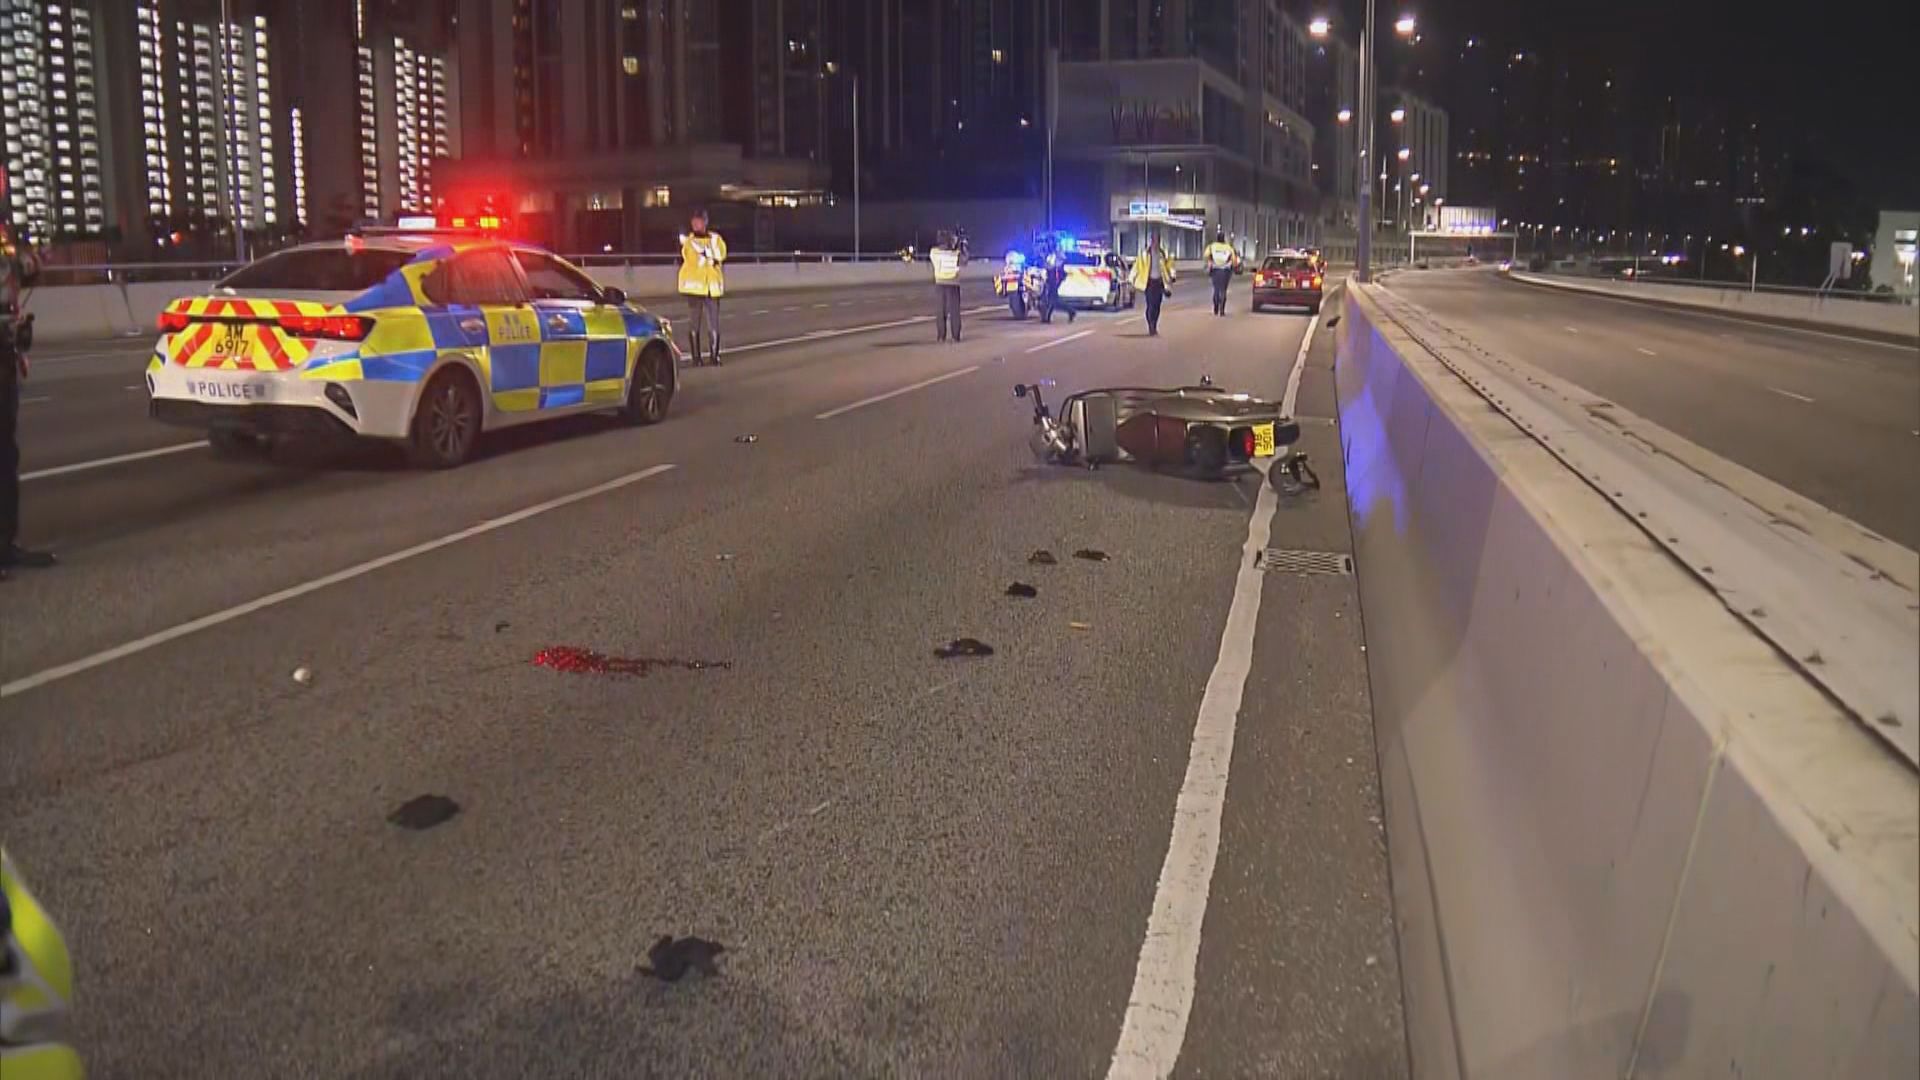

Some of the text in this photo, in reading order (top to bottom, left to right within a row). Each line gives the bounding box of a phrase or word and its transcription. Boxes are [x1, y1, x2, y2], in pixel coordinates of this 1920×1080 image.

[498, 325, 531, 340] POLICE
[215, 340, 249, 356] 6917
[198, 382, 251, 398] POLICE
